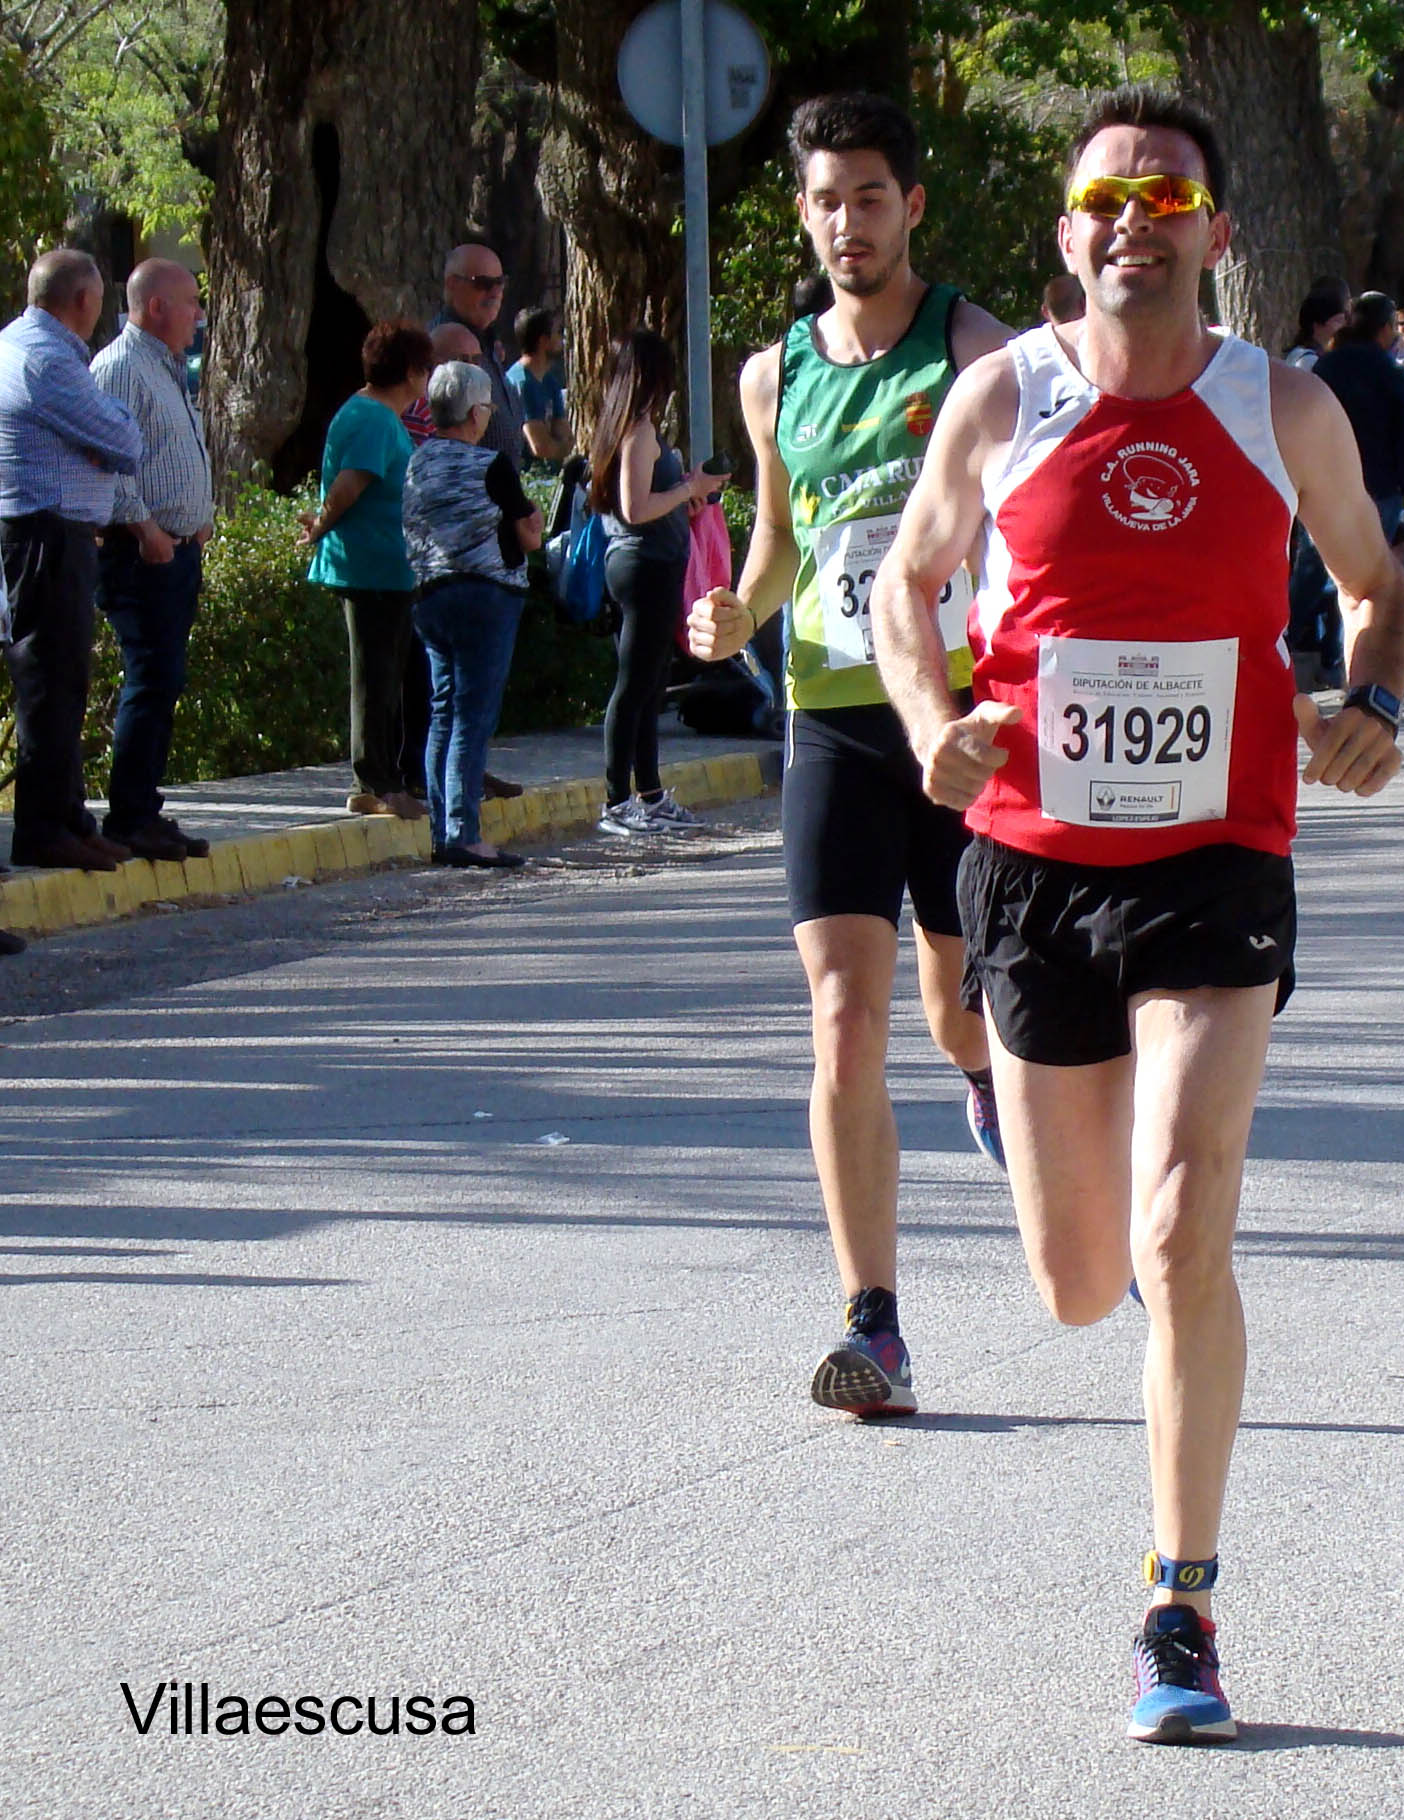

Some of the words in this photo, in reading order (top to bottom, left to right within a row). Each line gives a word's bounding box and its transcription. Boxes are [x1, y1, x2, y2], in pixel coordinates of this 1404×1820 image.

[1116, 441, 1178, 459] RUNNING
[1178, 457, 1200, 487] JARA
[1152, 522, 1168, 531] DE
[1168, 516, 1182, 527] LA
[1072, 677, 1133, 690] DIPUTACIÓN
[1136, 681, 1149, 690] DE
[1153, 679, 1203, 690] ALBACETE
[1062, 703, 1211, 765] 31929
[1119, 795, 1164, 803] RENAULT
